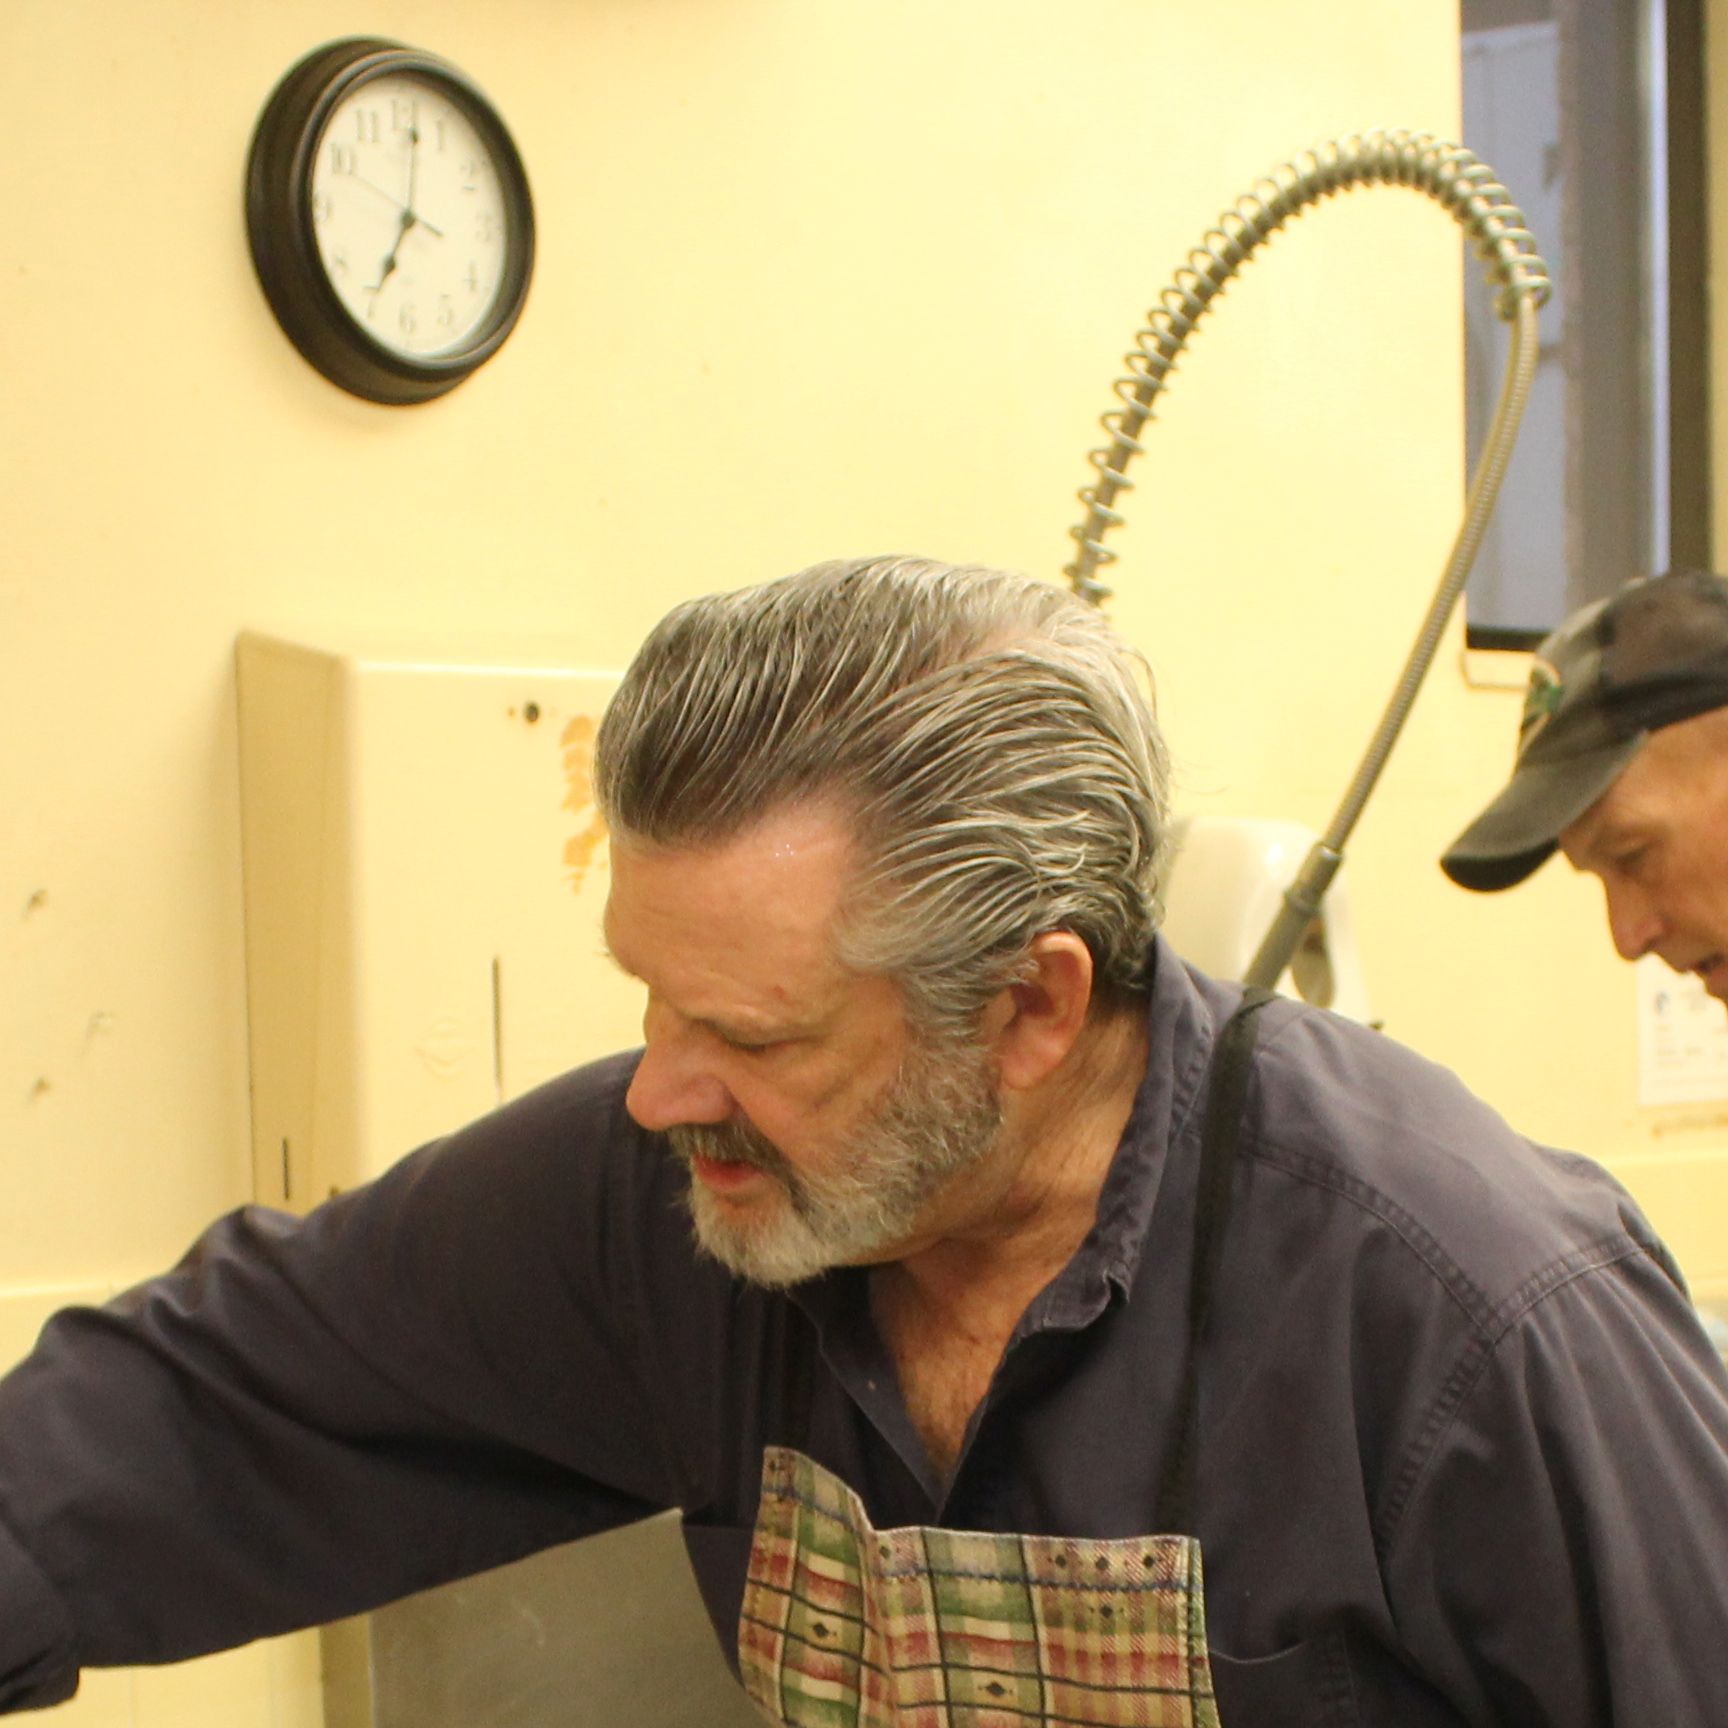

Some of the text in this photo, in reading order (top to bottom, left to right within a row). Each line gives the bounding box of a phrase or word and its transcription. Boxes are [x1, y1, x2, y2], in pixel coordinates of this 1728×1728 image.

[356, 109, 380, 143] 11
[436, 118, 448, 151] 1
[331, 141, 356, 177] 10
[314, 193, 332, 223] 9
[461, 260, 479, 292] 4
[398, 302, 417, 334] 6
[436, 293, 455, 327] 5
